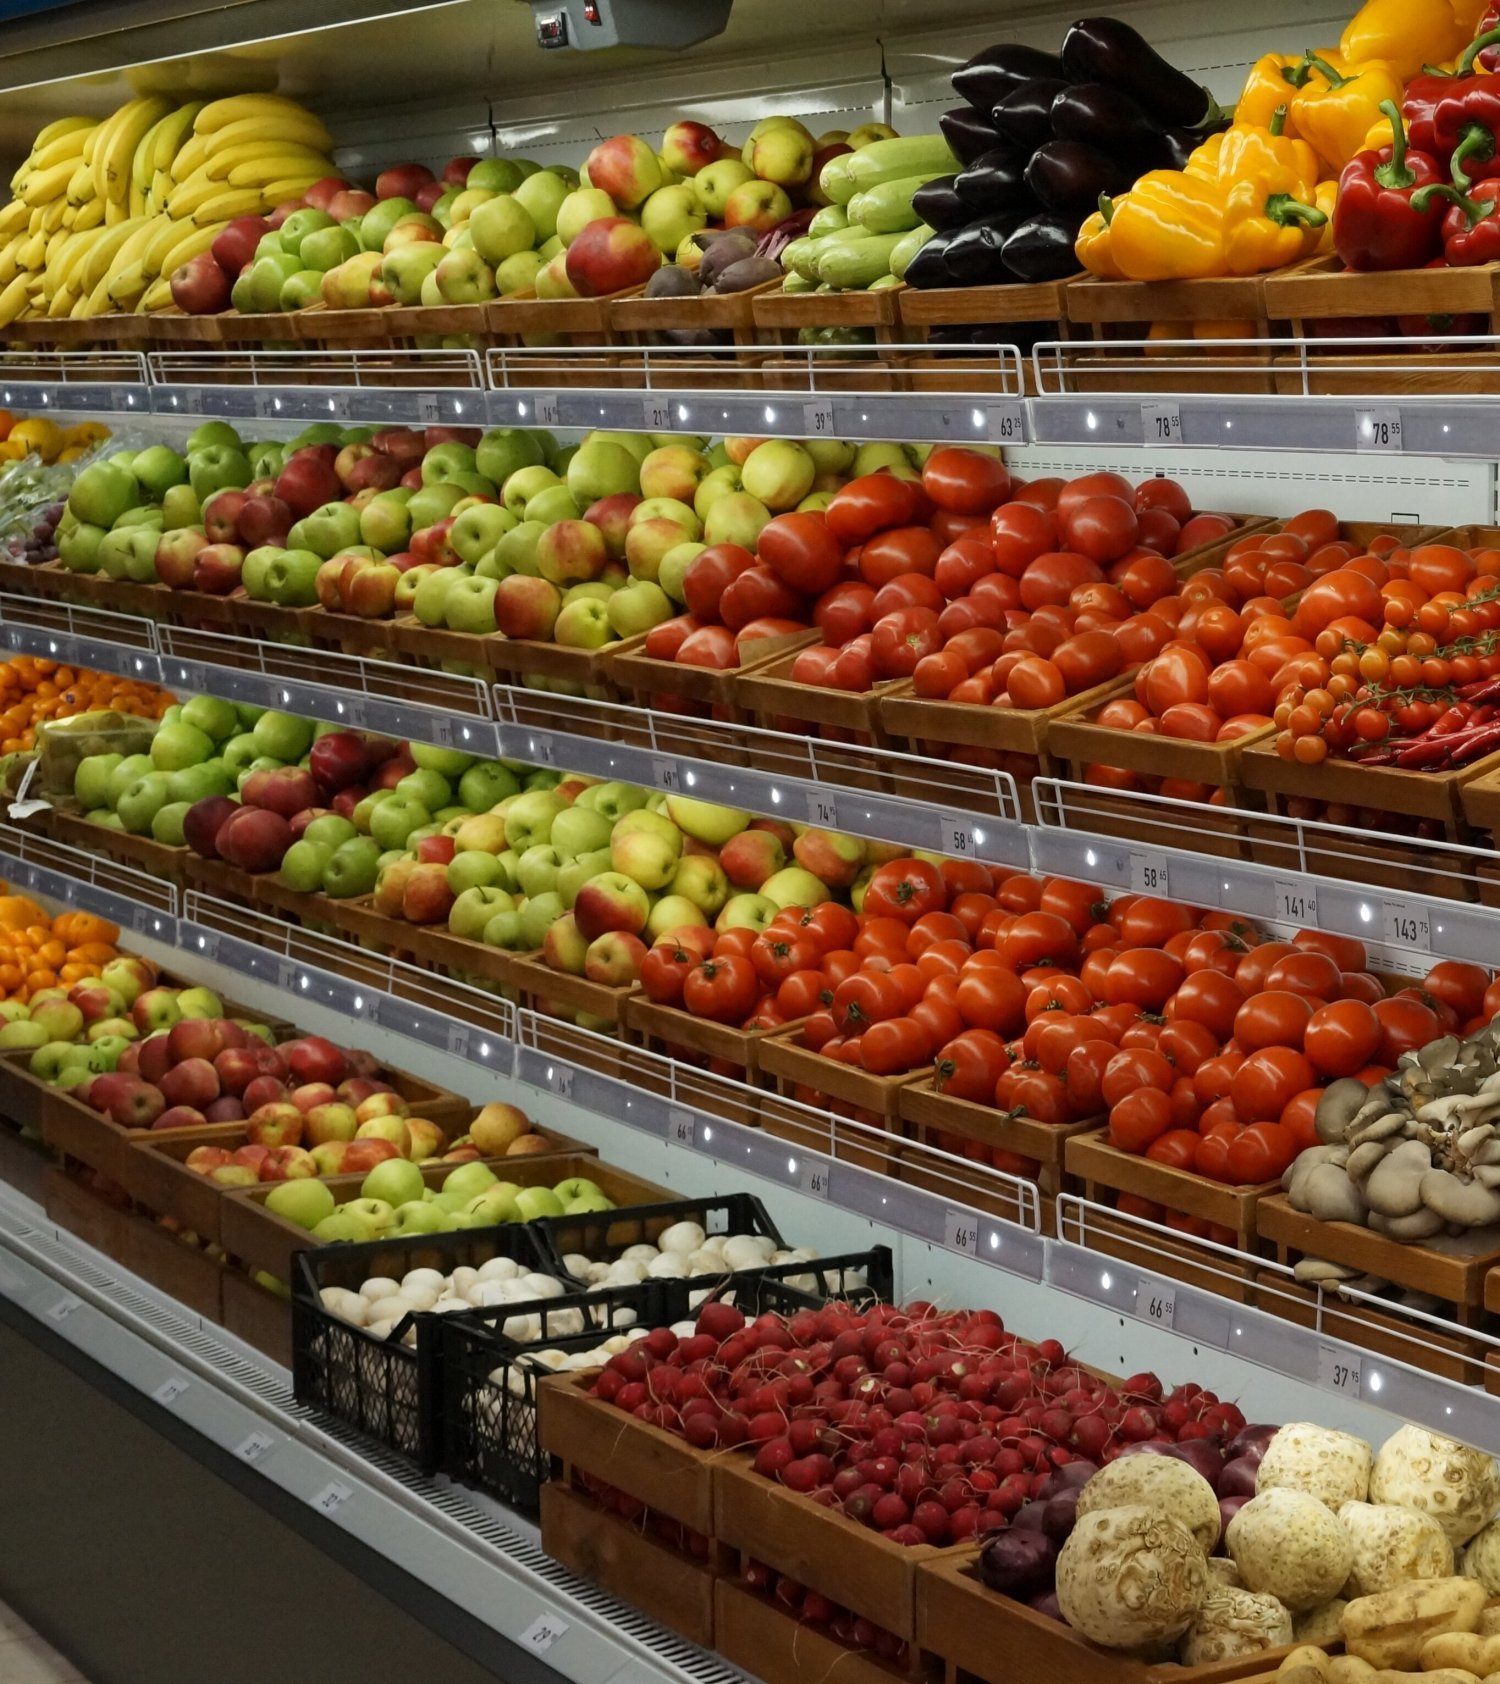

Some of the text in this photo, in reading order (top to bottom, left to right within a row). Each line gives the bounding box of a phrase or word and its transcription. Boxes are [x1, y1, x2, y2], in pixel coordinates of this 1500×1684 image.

[815, 412, 825, 430] 39
[1001, 418, 1012, 436] 63
[1156, 417, 1179, 437] 78 55
[1373, 423, 1400, 444] 78 55
[818, 804, 829, 821] 74
[954, 832, 965, 850] 58
[1144, 868, 1167, 888] 58 65
[1285, 895, 1315, 918] 141 40
[1394, 917, 1428, 941] 143 75
[677, 1123, 686, 1140] 66
[811, 1173, 821, 1191] 66
[956, 1227, 976, 1247] 66 55
[1150, 1297, 1172, 1318] 66 55
[1333, 1365, 1359, 1387] 37 95
